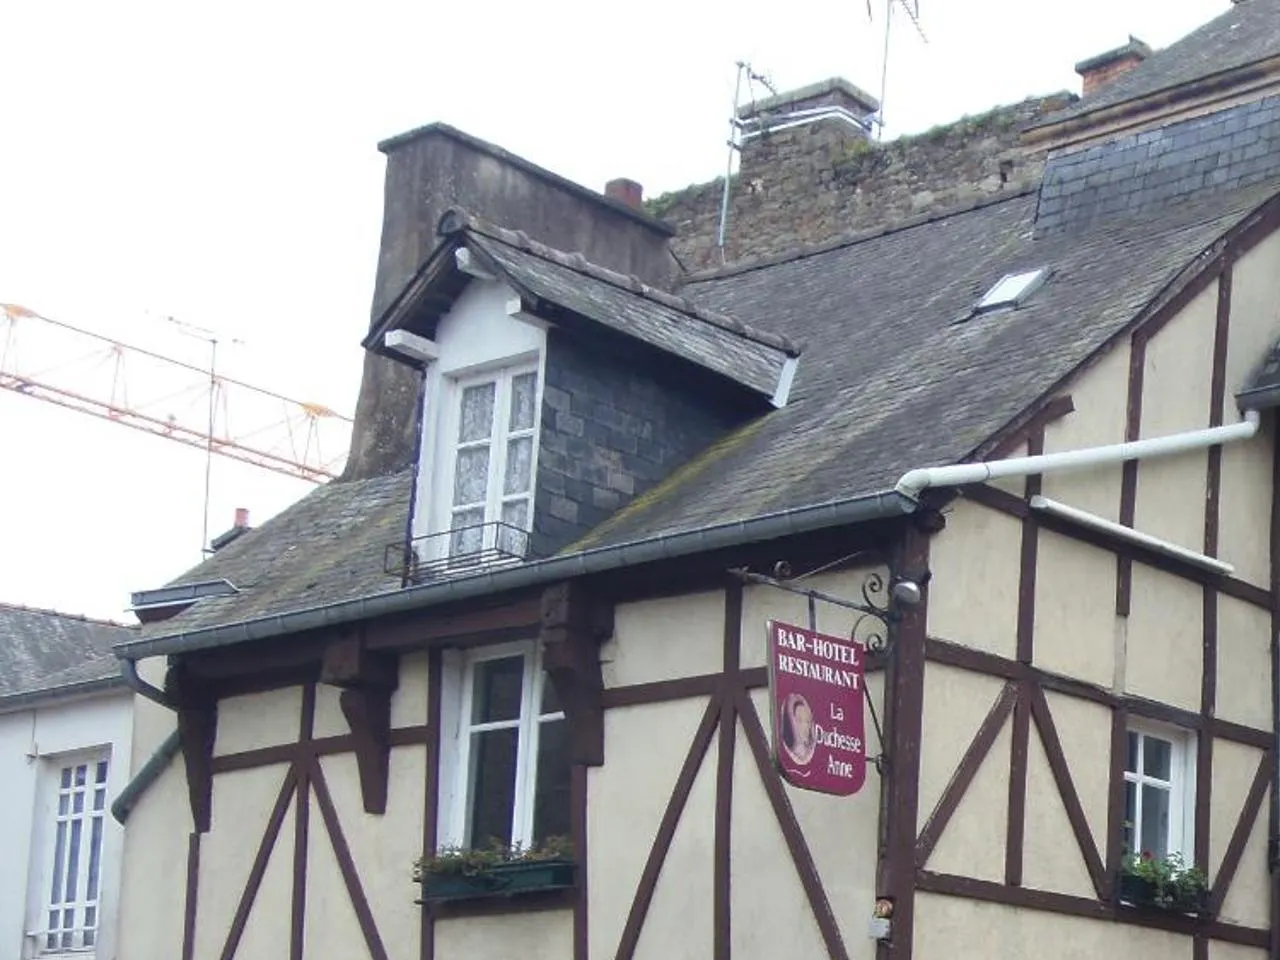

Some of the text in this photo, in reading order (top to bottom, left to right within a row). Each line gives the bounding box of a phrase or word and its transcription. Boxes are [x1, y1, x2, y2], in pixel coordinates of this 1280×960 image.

[777, 628, 860, 667] BAR-HOTEL
[778, 653, 860, 691] RESTAURANT
[830, 702, 844, 721] La
[815, 724, 861, 754] Duchesse
[827, 753, 853, 778] Anne
